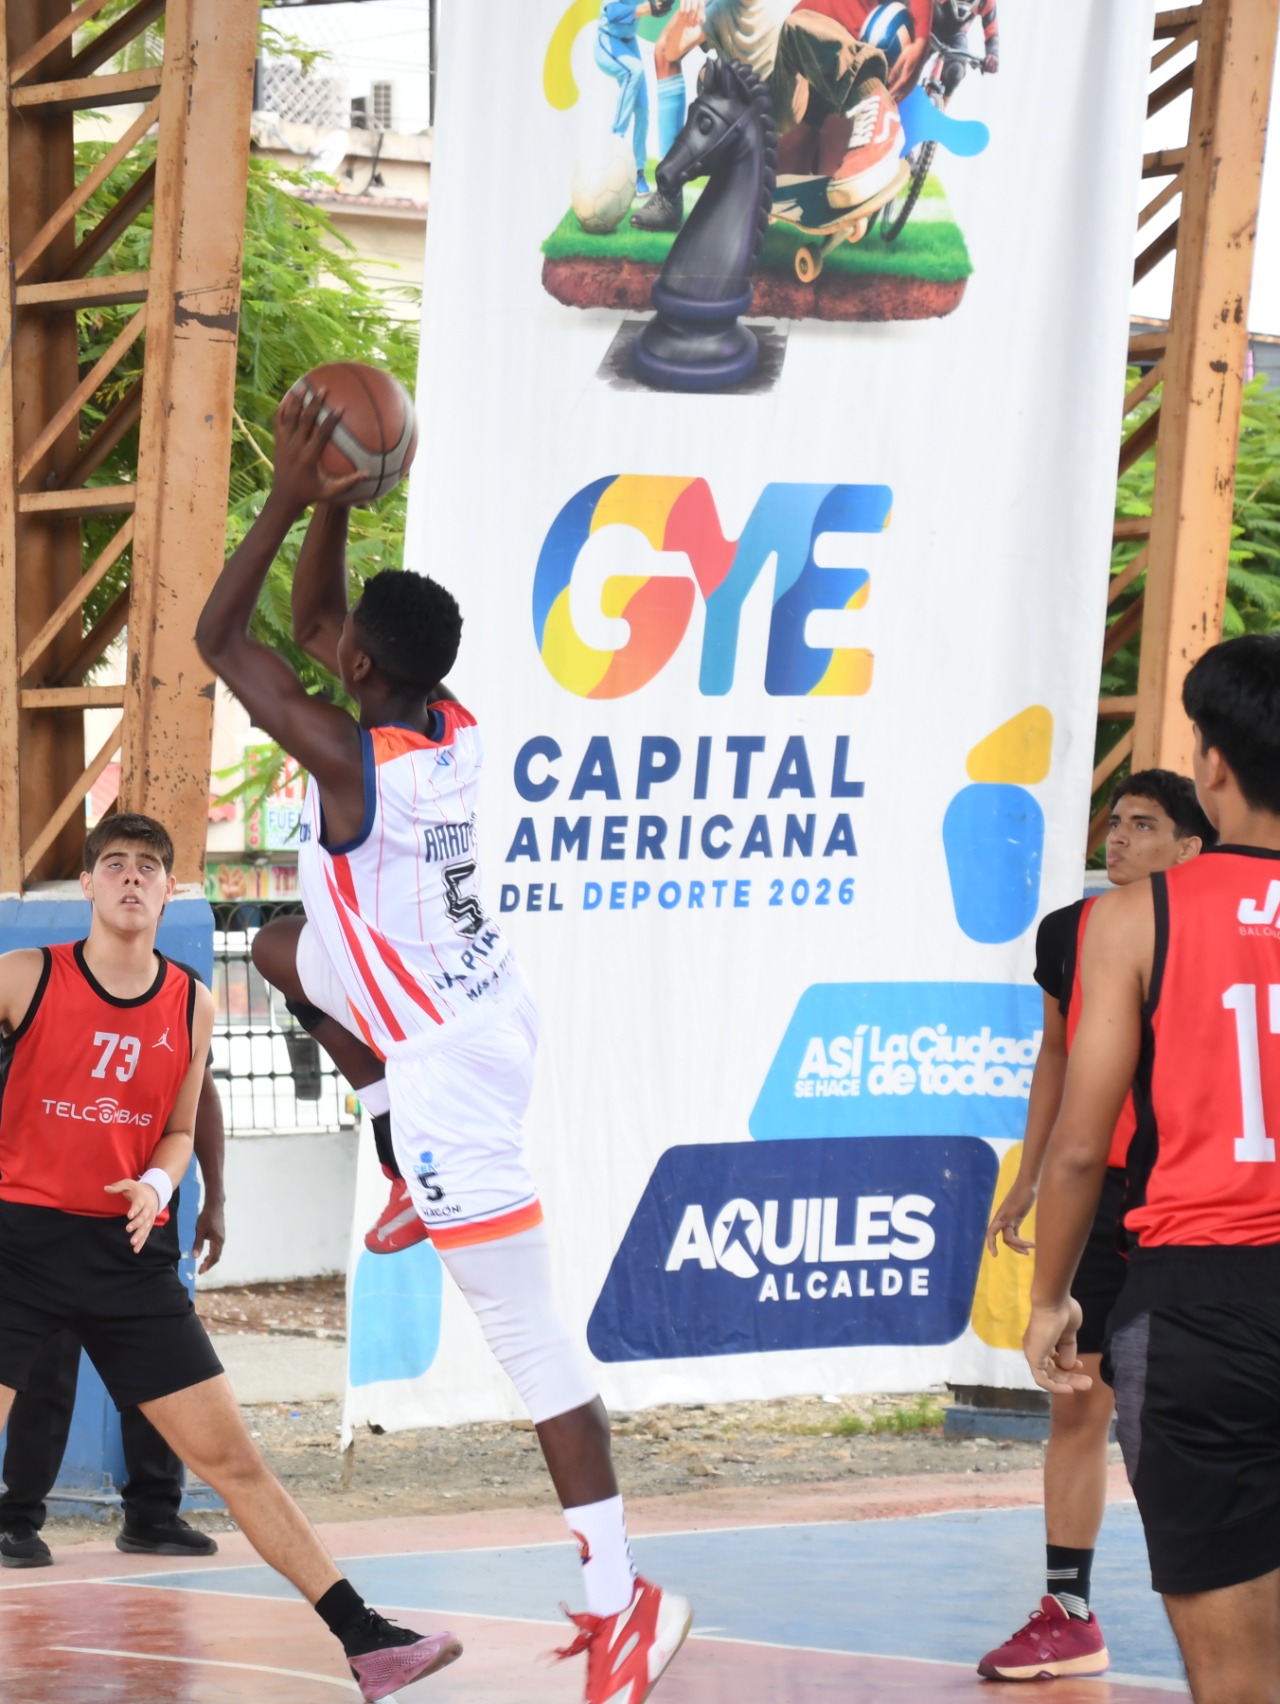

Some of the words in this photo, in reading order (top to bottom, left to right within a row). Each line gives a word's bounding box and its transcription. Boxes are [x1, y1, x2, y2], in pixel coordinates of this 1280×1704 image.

[532, 474, 893, 700] GYE
[513, 735, 866, 803] CAPITAL
[504, 813, 859, 863] AMERICANA
[499, 883, 564, 912] DEL
[583, 879, 752, 911] DEPORTE
[769, 877, 856, 907] 2026
[91, 1031, 141, 1082] 73
[798, 1024, 869, 1079] ASÍ
[869, 1025, 909, 1063] La
[794, 1080, 815, 1098] SE
[816, 1078, 861, 1097] HACE
[867, 1061, 916, 1096] de
[665, 1194, 936, 1279] AQUILES
[759, 1268, 930, 1302] ALCALDE
